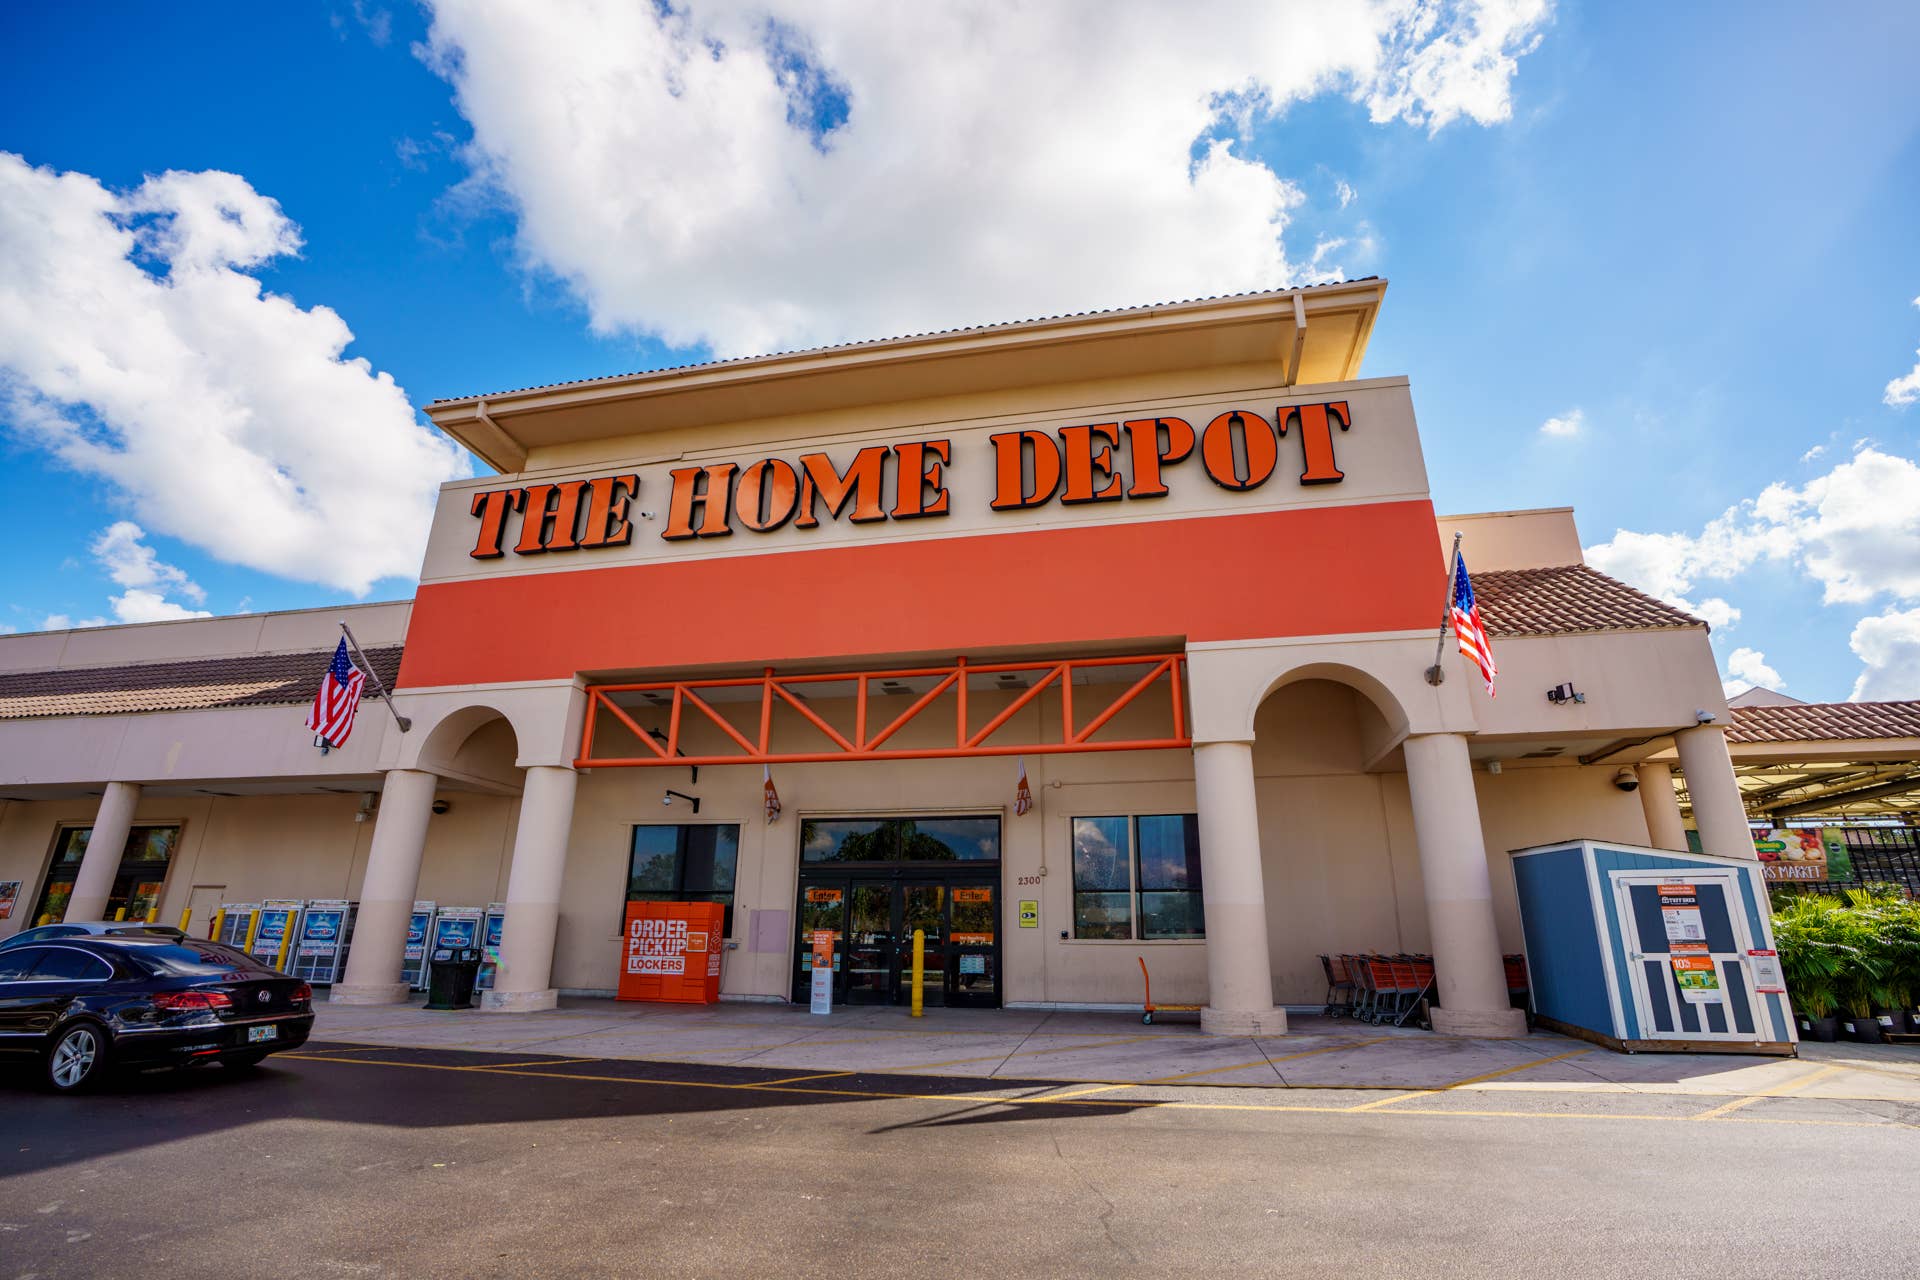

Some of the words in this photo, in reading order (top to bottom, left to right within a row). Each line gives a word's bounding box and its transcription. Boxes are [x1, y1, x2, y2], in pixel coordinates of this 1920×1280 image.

[470, 474, 640, 559] THE
[661, 439, 951, 541] HOME
[989, 401, 1351, 511] DEPOT
[1779, 865, 1821, 879] MARKET
[1018, 876, 1041, 886] 2300
[813, 891, 836, 901] Enter
[960, 891, 984, 901] Enter
[631, 919, 688, 938] ORDER
[628, 938, 688, 956] PICKUP
[630, 959, 683, 970] LOCKERS
